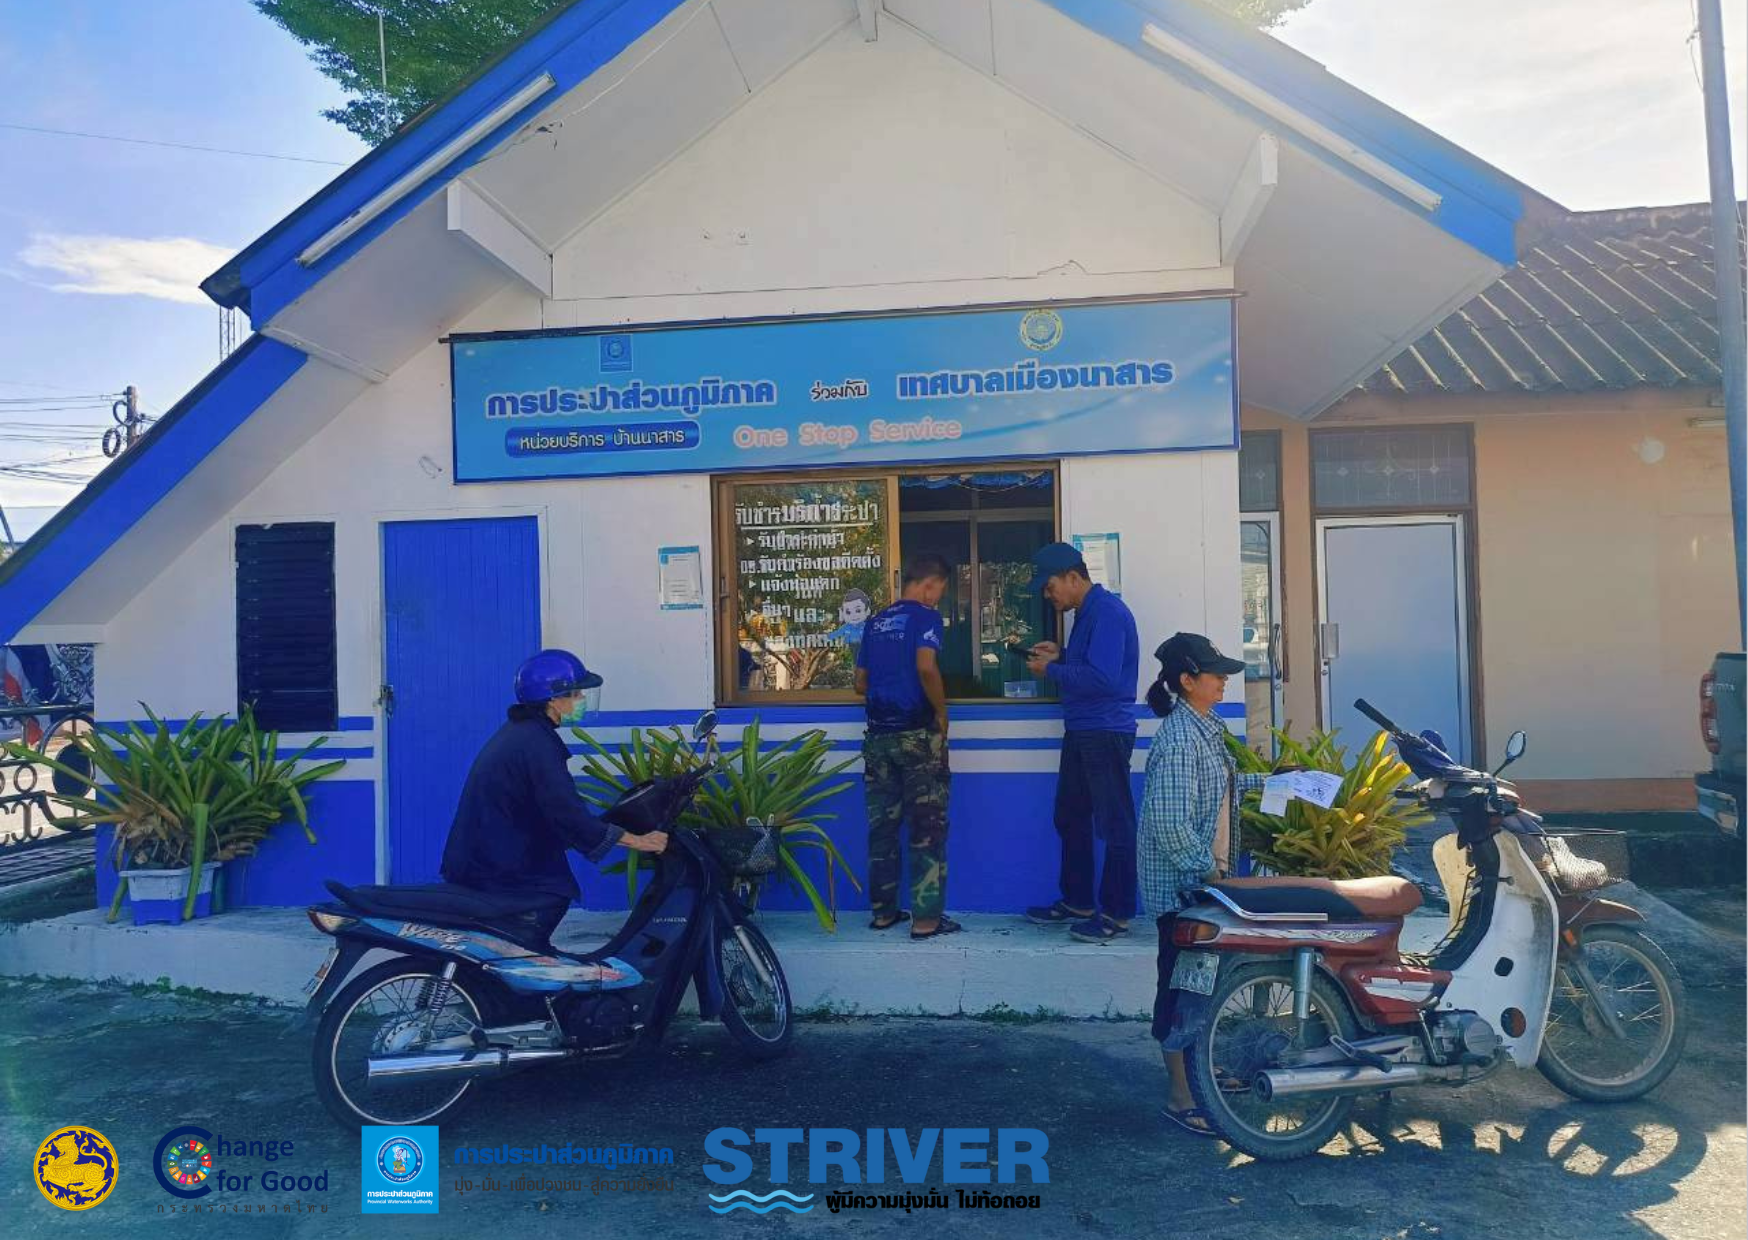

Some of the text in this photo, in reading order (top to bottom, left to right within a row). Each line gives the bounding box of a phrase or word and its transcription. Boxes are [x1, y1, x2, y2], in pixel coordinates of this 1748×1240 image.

[486, 358, 1176, 416] การประปาส่วนภูมิภาค ร่วมกับ เทศบาลเมืองนาสาร
[520, 426, 685, 452] หน่วยบริการ บ้านนาสาร
[733, 416, 962, 448] One Stop Service
